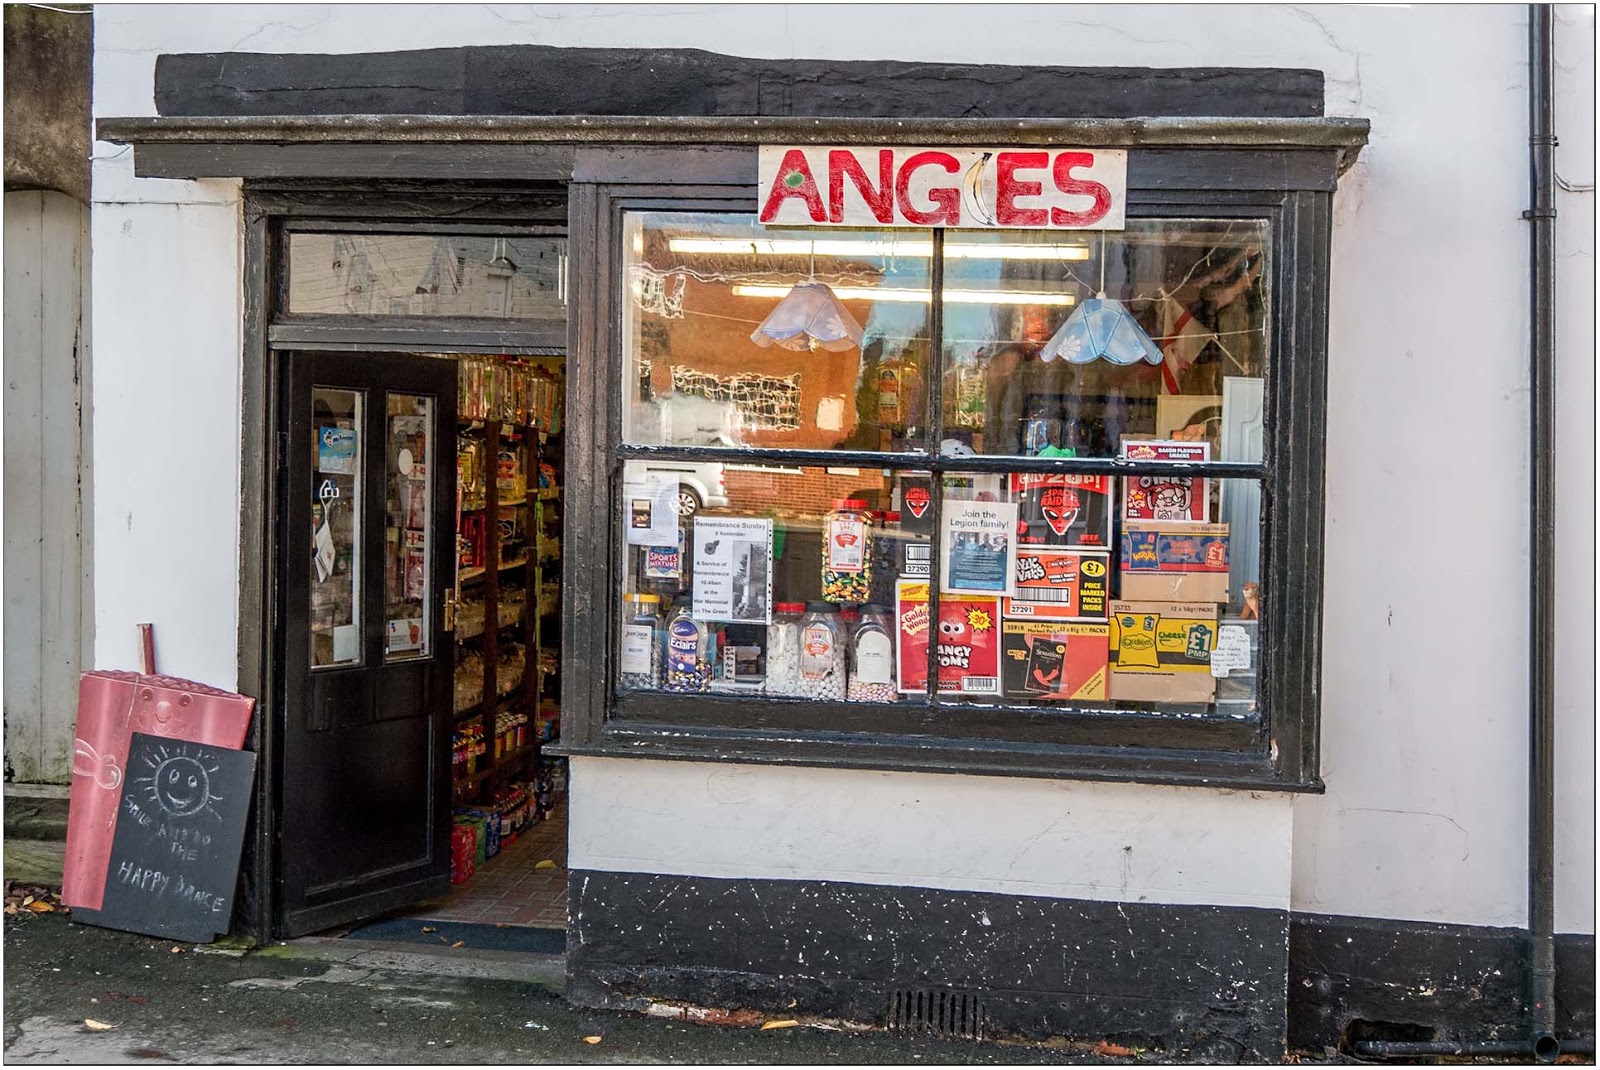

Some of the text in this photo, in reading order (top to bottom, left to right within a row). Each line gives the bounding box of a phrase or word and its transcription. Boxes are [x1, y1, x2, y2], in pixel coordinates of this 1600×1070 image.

[962, 509, 997, 519] Join the
[695, 521, 766, 531] Remembrance Sunday
[950, 518, 1009, 529] Legion family!
[649, 552, 678, 562] SPORTS
[649, 560, 678, 570] MIXTURE
[907, 565, 929, 573] 27290
[1086, 562, 1100, 574] £1
[1084, 582, 1101, 590] PRICE
[1080, 589, 1105, 597] MARKED
[1083, 596, 1103, 604] PACKS
[1012, 605, 1032, 613] 27291
[1082, 604, 1102, 612] INSIDE
[905, 608, 929, 623] Golde
[906, 617, 929, 631] Wond
[1158, 631, 1187, 640] Cheese
[670, 637, 697, 651] Eclairs
[1189, 631, 1211, 651] £1
[1187, 650, 1208, 658] PMP
[938, 655, 970, 669] OMS
[123, 793, 154, 827] SMILE
[170, 841, 200, 862] THE
[117, 860, 226, 913] HAPPY DANCE
